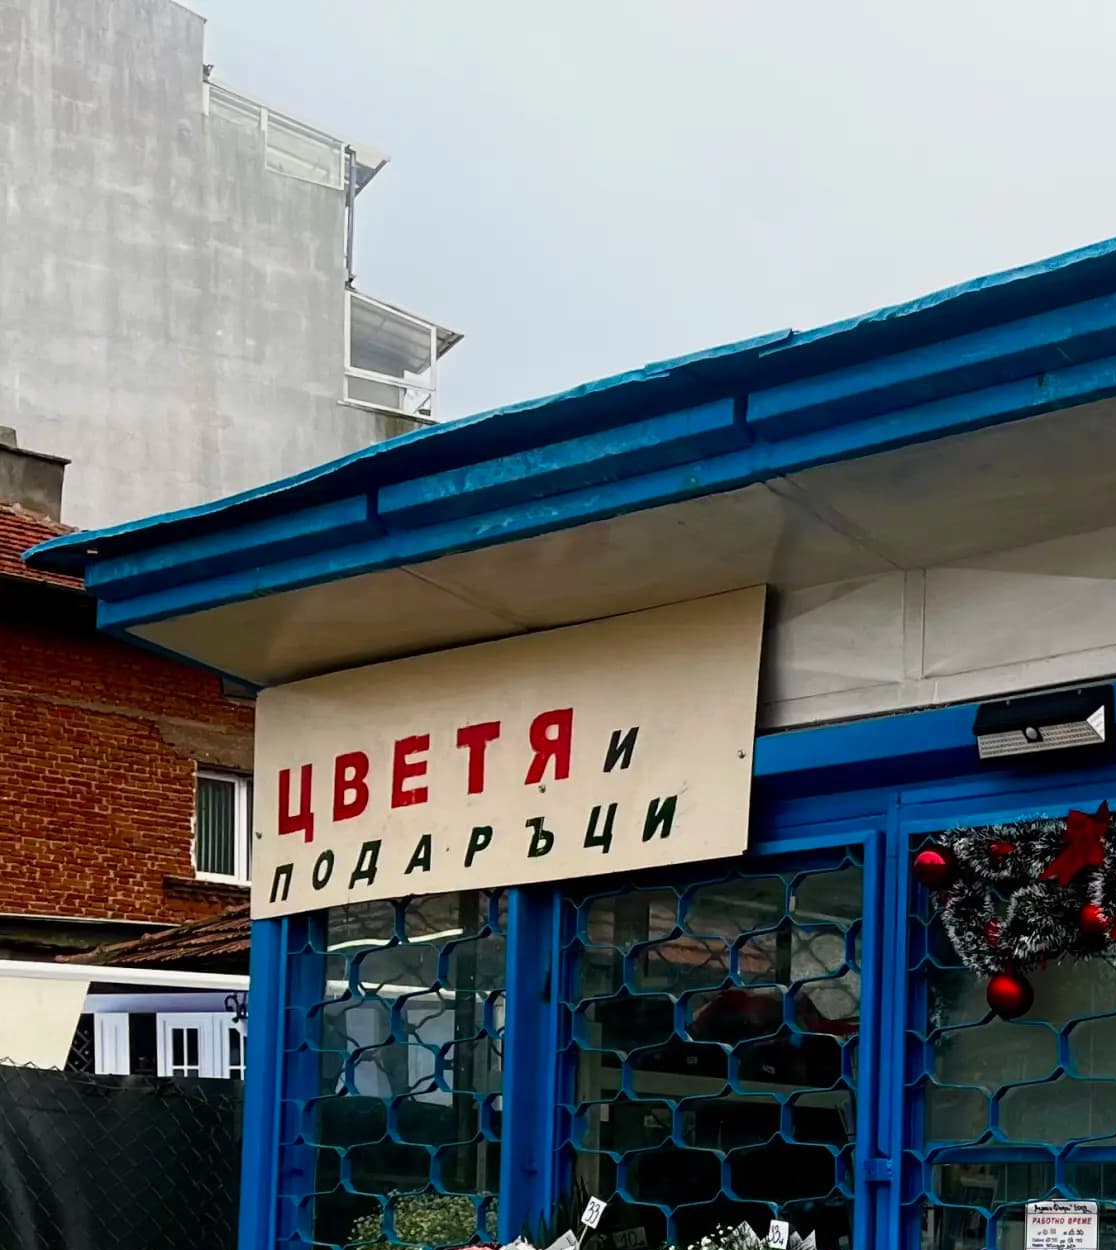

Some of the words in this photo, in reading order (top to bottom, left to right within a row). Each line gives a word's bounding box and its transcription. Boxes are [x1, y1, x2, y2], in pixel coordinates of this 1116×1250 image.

[278, 708, 573, 843] ЦВЕТЯ
[269, 795, 679, 903] ПОДАРЪЦИ
[584, 1201, 600, 1225] 33
[1032, 1217, 1065, 1225] РАБОТНО
[1067, 1217, 1092, 1225] ВРЕМЕ
